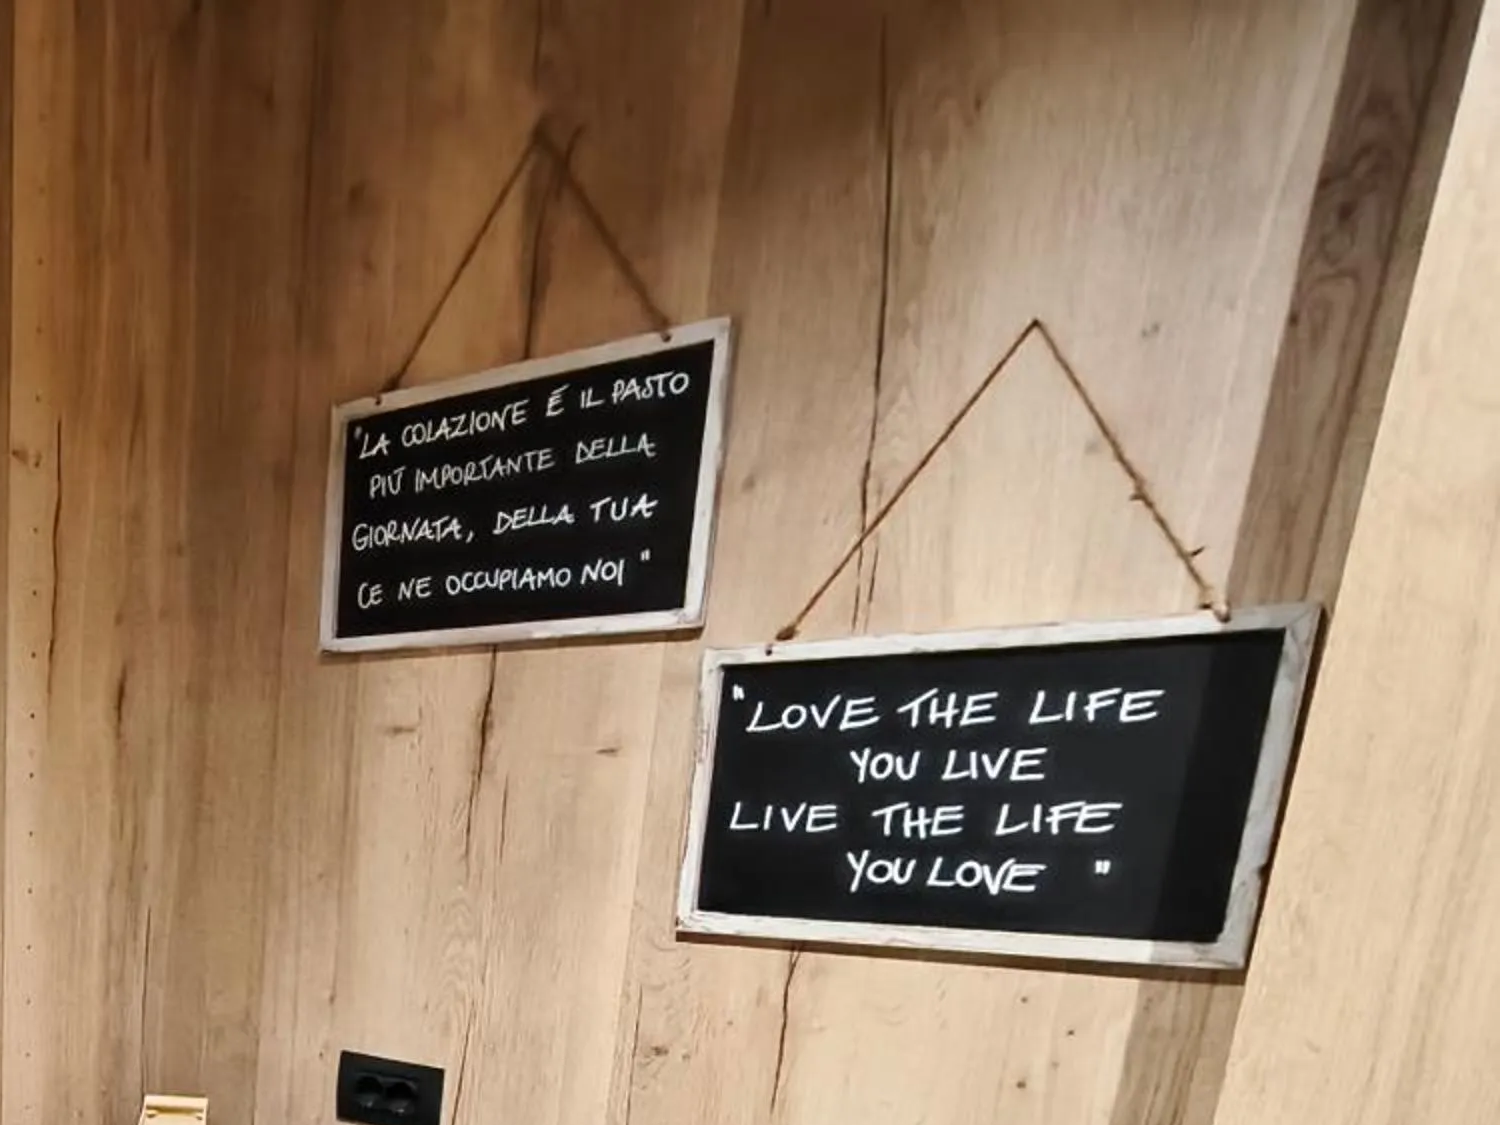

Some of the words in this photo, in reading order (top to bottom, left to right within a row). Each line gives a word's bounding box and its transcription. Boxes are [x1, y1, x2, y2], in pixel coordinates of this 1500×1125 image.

[401, 399, 529, 448] COLAZIONE
[580, 387, 604, 409] IL
[611, 371, 690, 404] PASTO
[415, 448, 554, 493] IMPORTANTE
[575, 433, 656, 465] DELLA
[352, 515, 474, 551] GIORNATA,
[492, 504, 575, 535] DELLA
[589, 493, 659, 523] TUA
[357, 582, 383, 609] CE
[397, 576, 432, 601] NE
[445, 567, 572, 596] OCCUPIAMO
[580, 558, 625, 587] NOI
[896, 687, 999, 729] THE
[1028, 687, 1165, 725] LIFE
[849, 747, 921, 784] YOU
[941, 747, 1048, 782] LIVE
[729, 801, 837, 833] LIVE
[871, 801, 964, 840] THE
[994, 800, 1123, 836] LIFE
[846, 849, 917, 893] YOU
[926, 856, 1047, 896] LOVE
